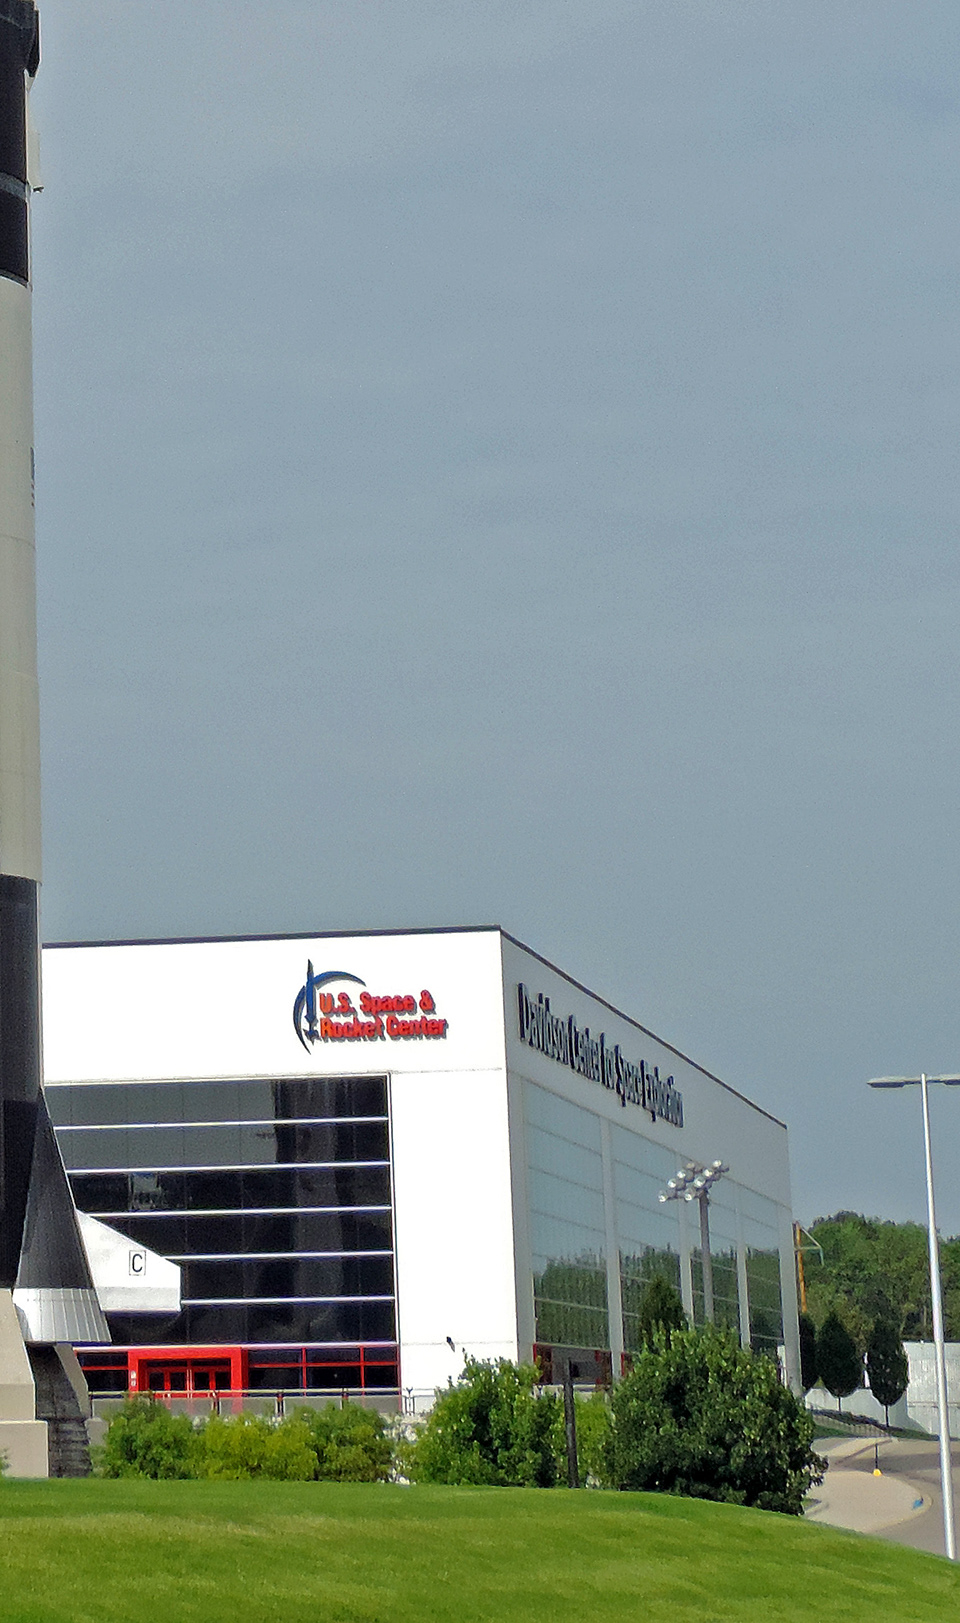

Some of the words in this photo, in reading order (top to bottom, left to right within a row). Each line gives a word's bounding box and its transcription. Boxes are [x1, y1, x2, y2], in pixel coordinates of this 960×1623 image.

[319, 992, 356, 1014] U.S.
[359, 991, 416, 1016] Space
[419, 989, 435, 1012] &
[320, 1016, 383, 1038] Rocket
[386, 1015, 447, 1037] Center
[132, 1253, 143, 1273] C
